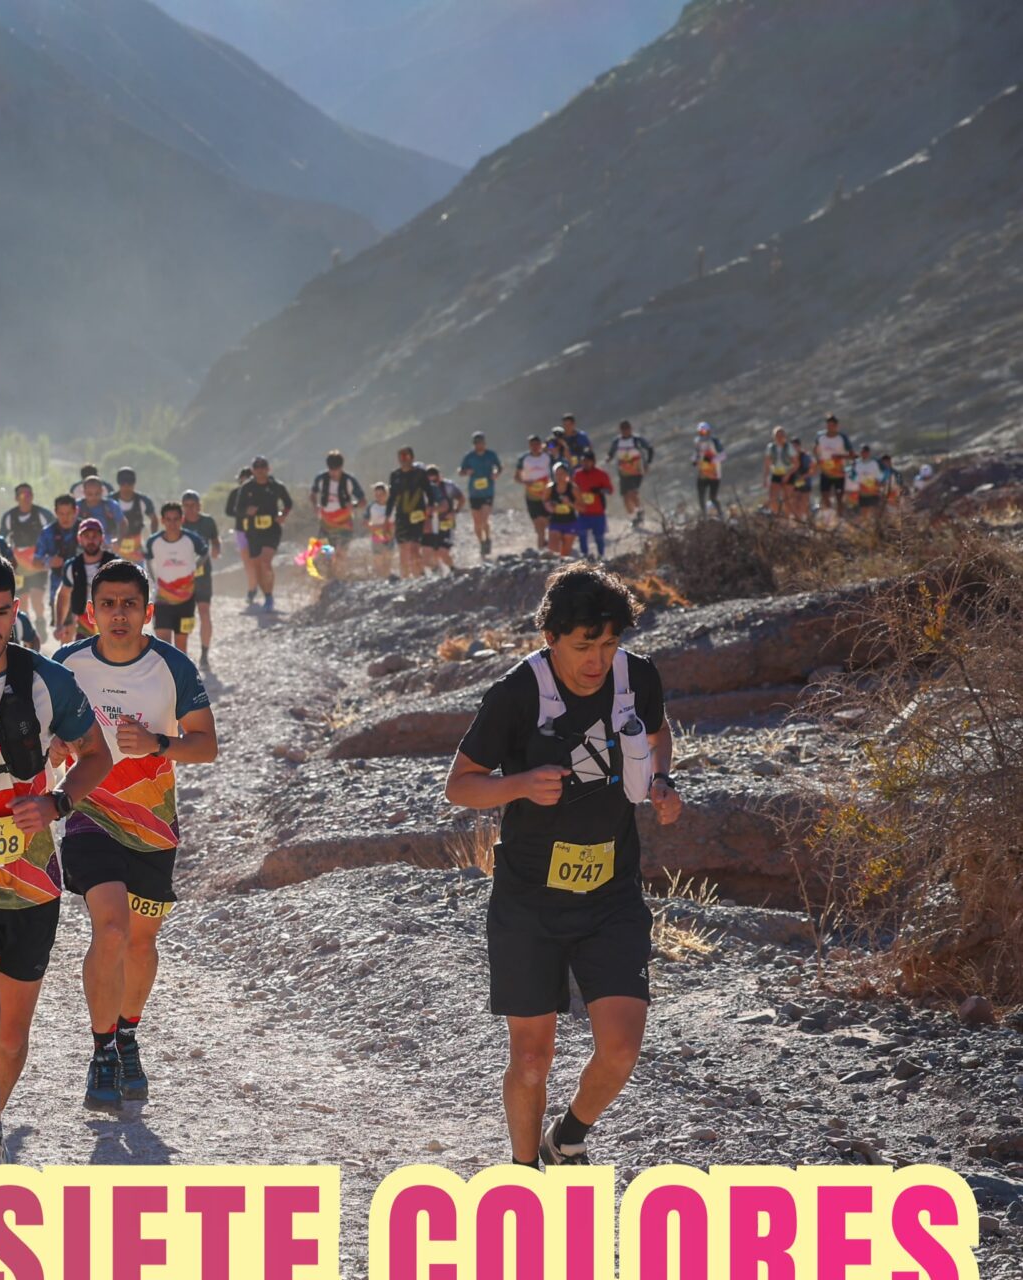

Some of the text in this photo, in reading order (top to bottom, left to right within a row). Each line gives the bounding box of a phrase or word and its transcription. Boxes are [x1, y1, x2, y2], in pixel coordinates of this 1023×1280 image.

[102, 706, 123, 714] TRAIL
[136, 713, 143, 721] 7
[559, 863, 603, 882] 0747
